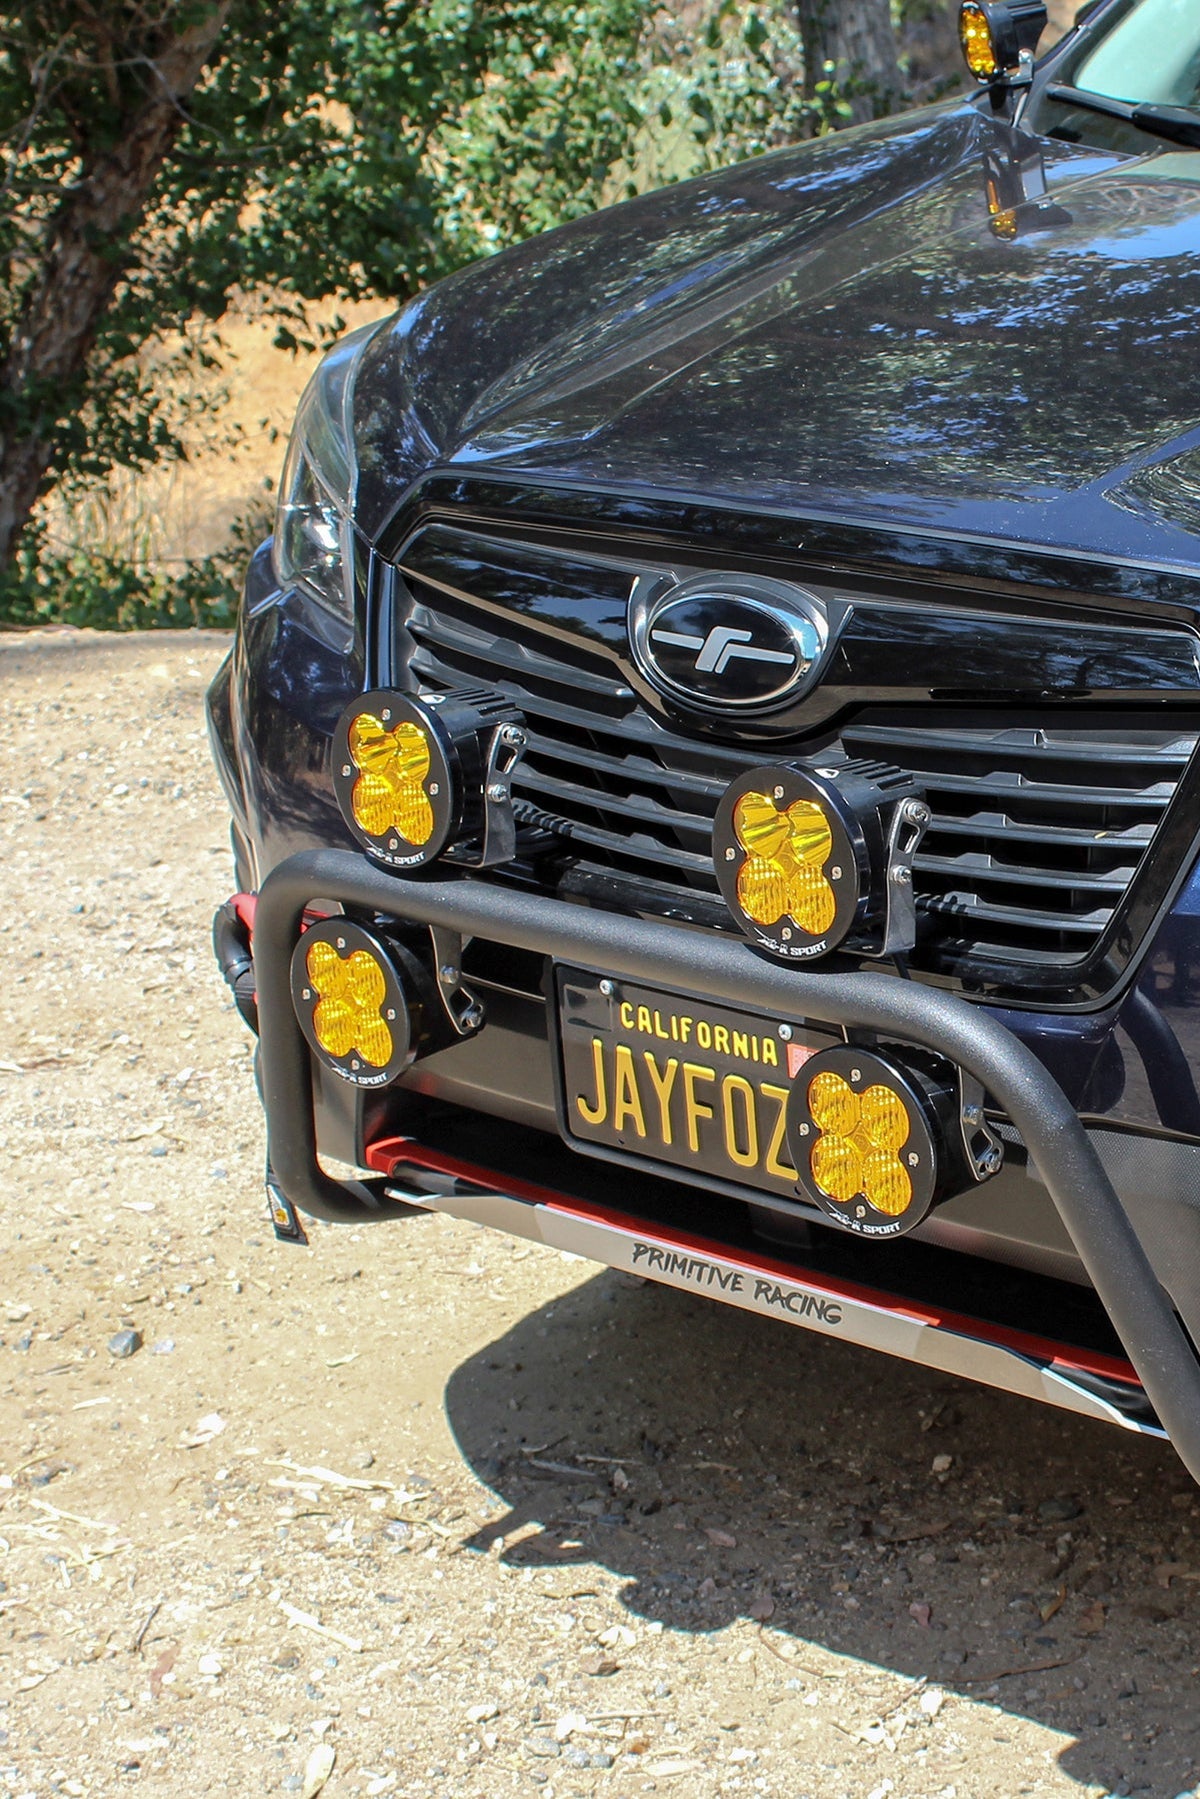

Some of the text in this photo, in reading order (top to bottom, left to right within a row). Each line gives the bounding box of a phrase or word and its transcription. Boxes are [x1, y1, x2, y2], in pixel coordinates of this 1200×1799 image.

[393, 851, 425, 865] SPORT
[790, 940, 827, 956] SPORT
[620, 1002, 779, 1067] CALIFORNIA
[357, 1072, 388, 1085] SPORT
[577, 1038, 799, 1181] JAYFOZ
[862, 1221, 900, 1234] SPORT
[632, 1242, 843, 1325] PRIMITIVE RACING
